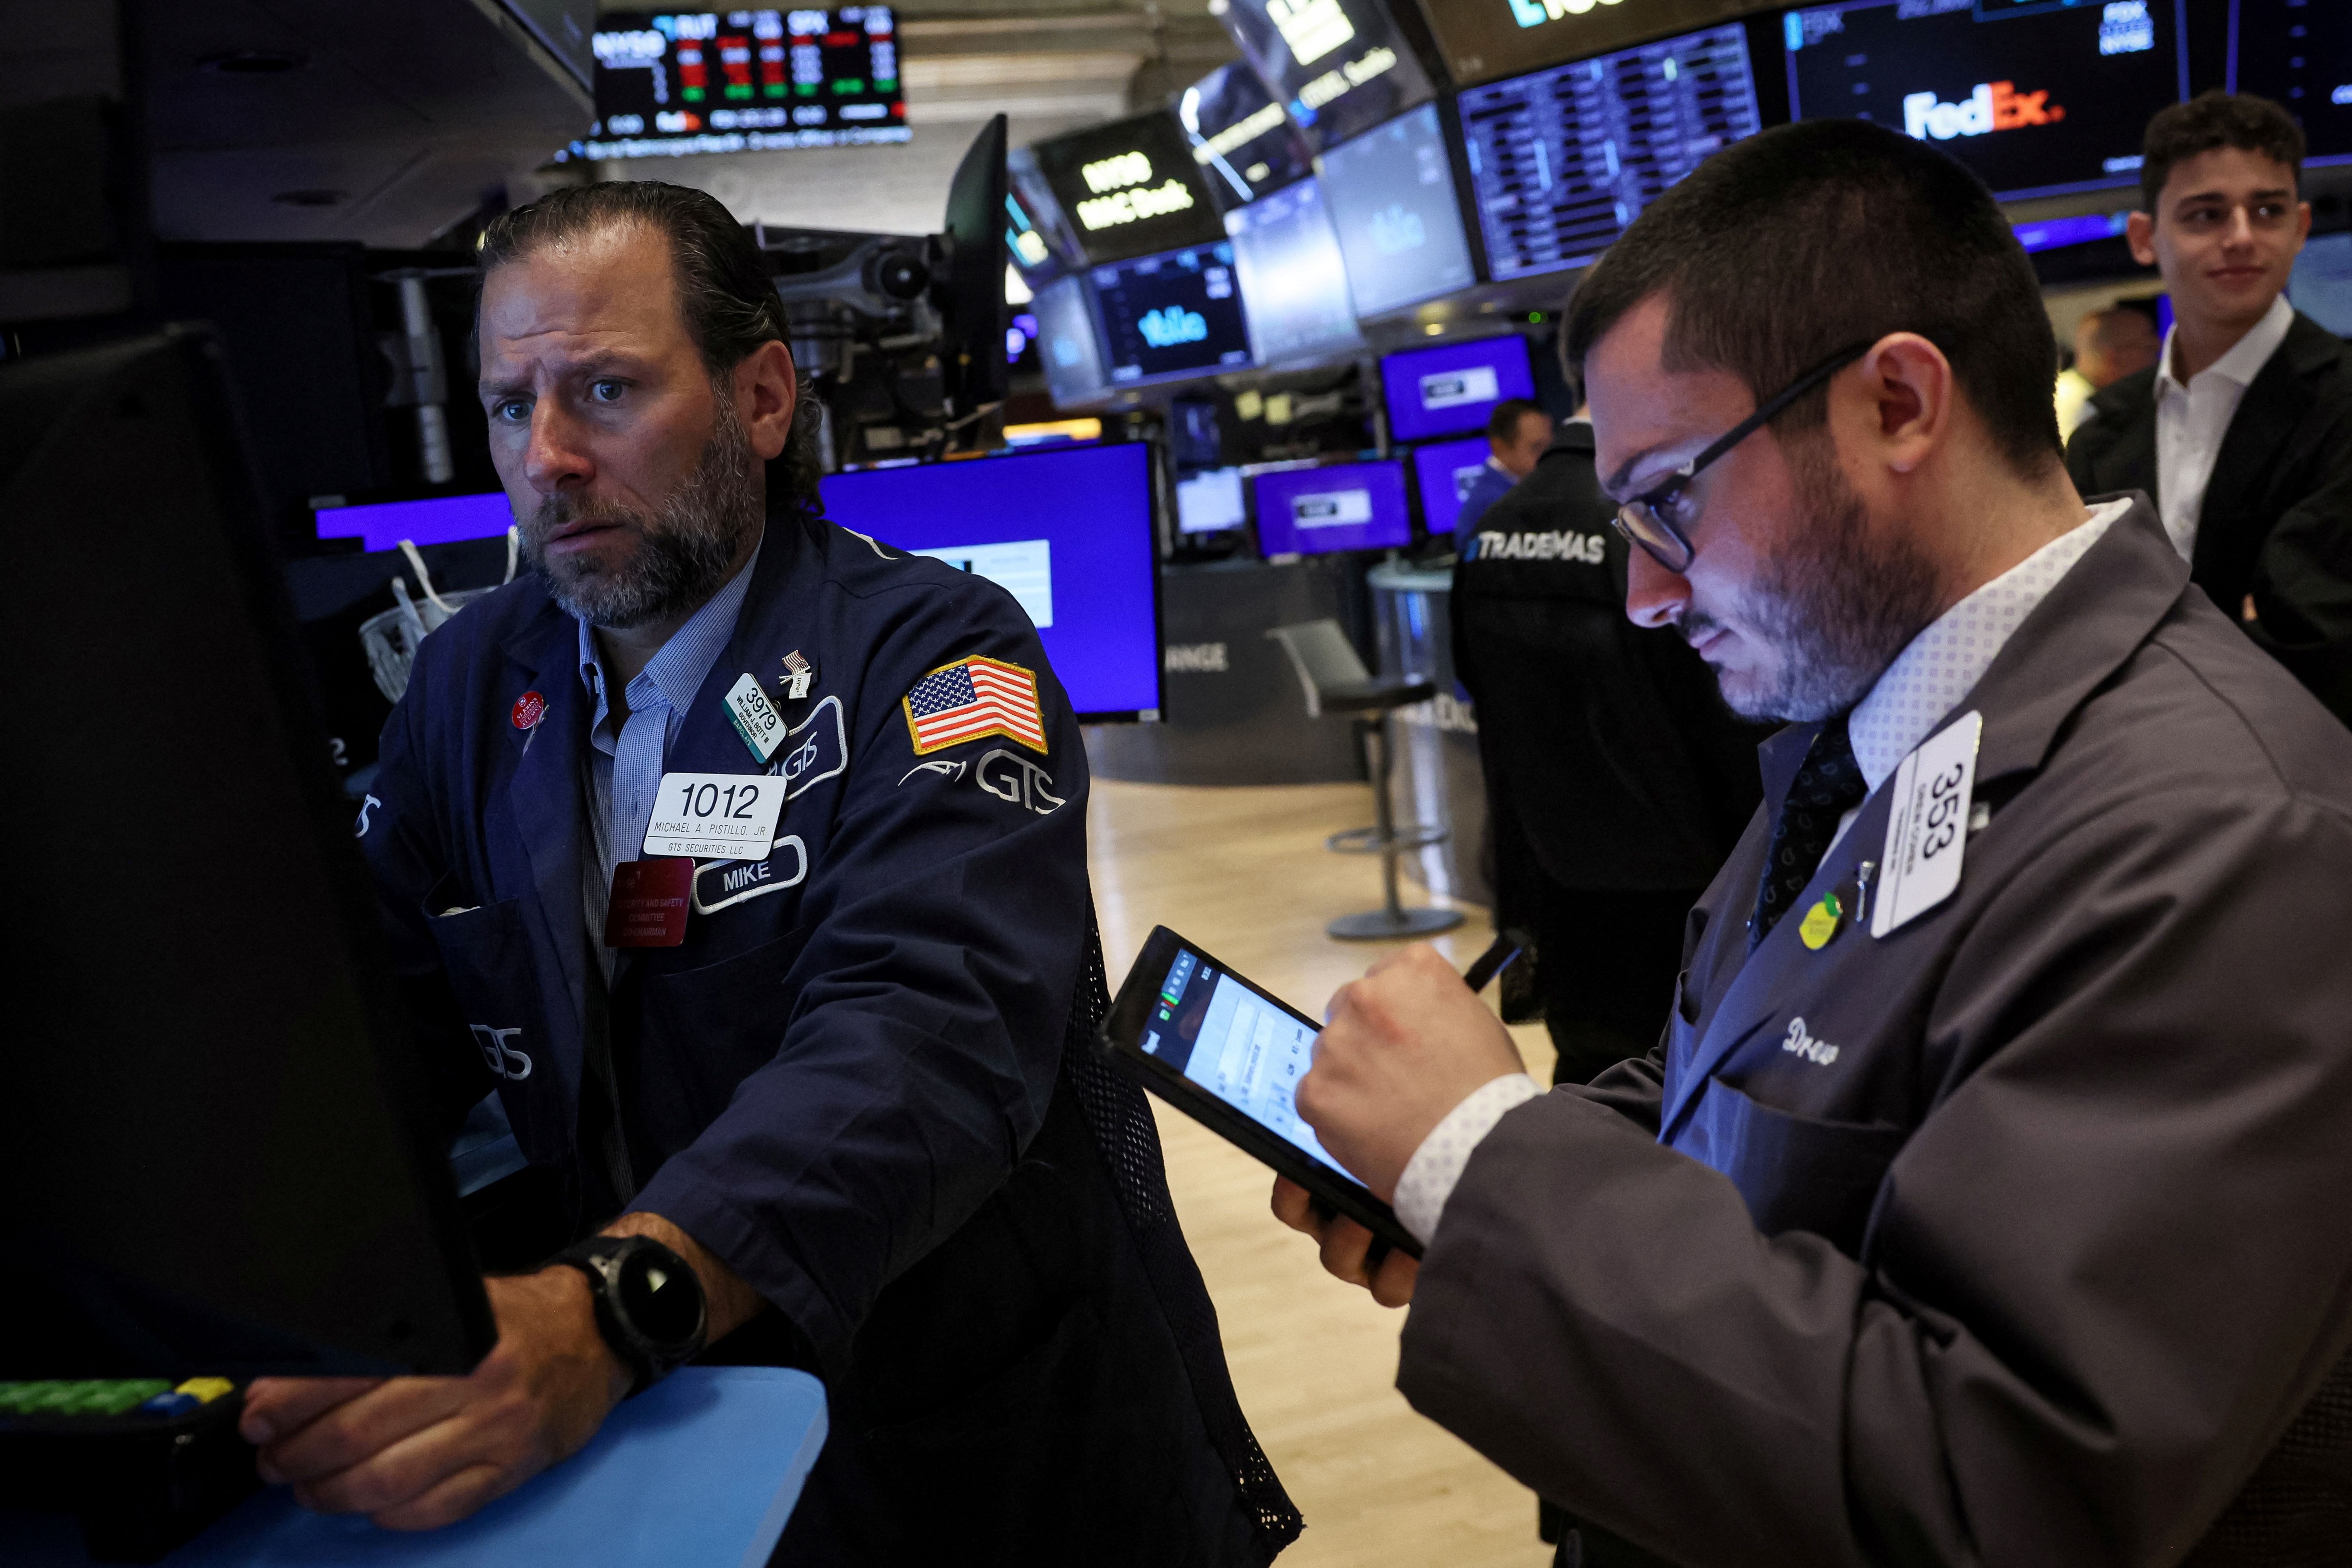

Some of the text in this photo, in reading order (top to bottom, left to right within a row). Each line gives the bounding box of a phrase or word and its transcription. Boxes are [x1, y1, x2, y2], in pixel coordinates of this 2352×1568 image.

[736, 695, 752, 719] WILLIAM
[753, 722, 767, 739] BOTT
[746, 687, 776, 730] 3979
[733, 719, 752, 746] BARCLAYS
[738, 712, 758, 739] GOVERNOR
[781, 731, 818, 781] GTS
[976, 749, 1067, 815] GTS
[682, 783, 759, 819] 1012
[1923, 762, 1964, 859] 353
[654, 822, 690, 833] MICHAEL
[695, 823, 703, 833] A.
[753, 826, 767, 836] JR.
[668, 843, 744, 855] GTS SECURITIES LLC
[723, 860, 771, 893] MIKE
[628, 912, 665, 922] COMMITTEE
[645, 899, 659, 908] AND
[659, 898, 684, 908] SAFETY
[622, 927, 667, 937] CO-CHAIRMAN
